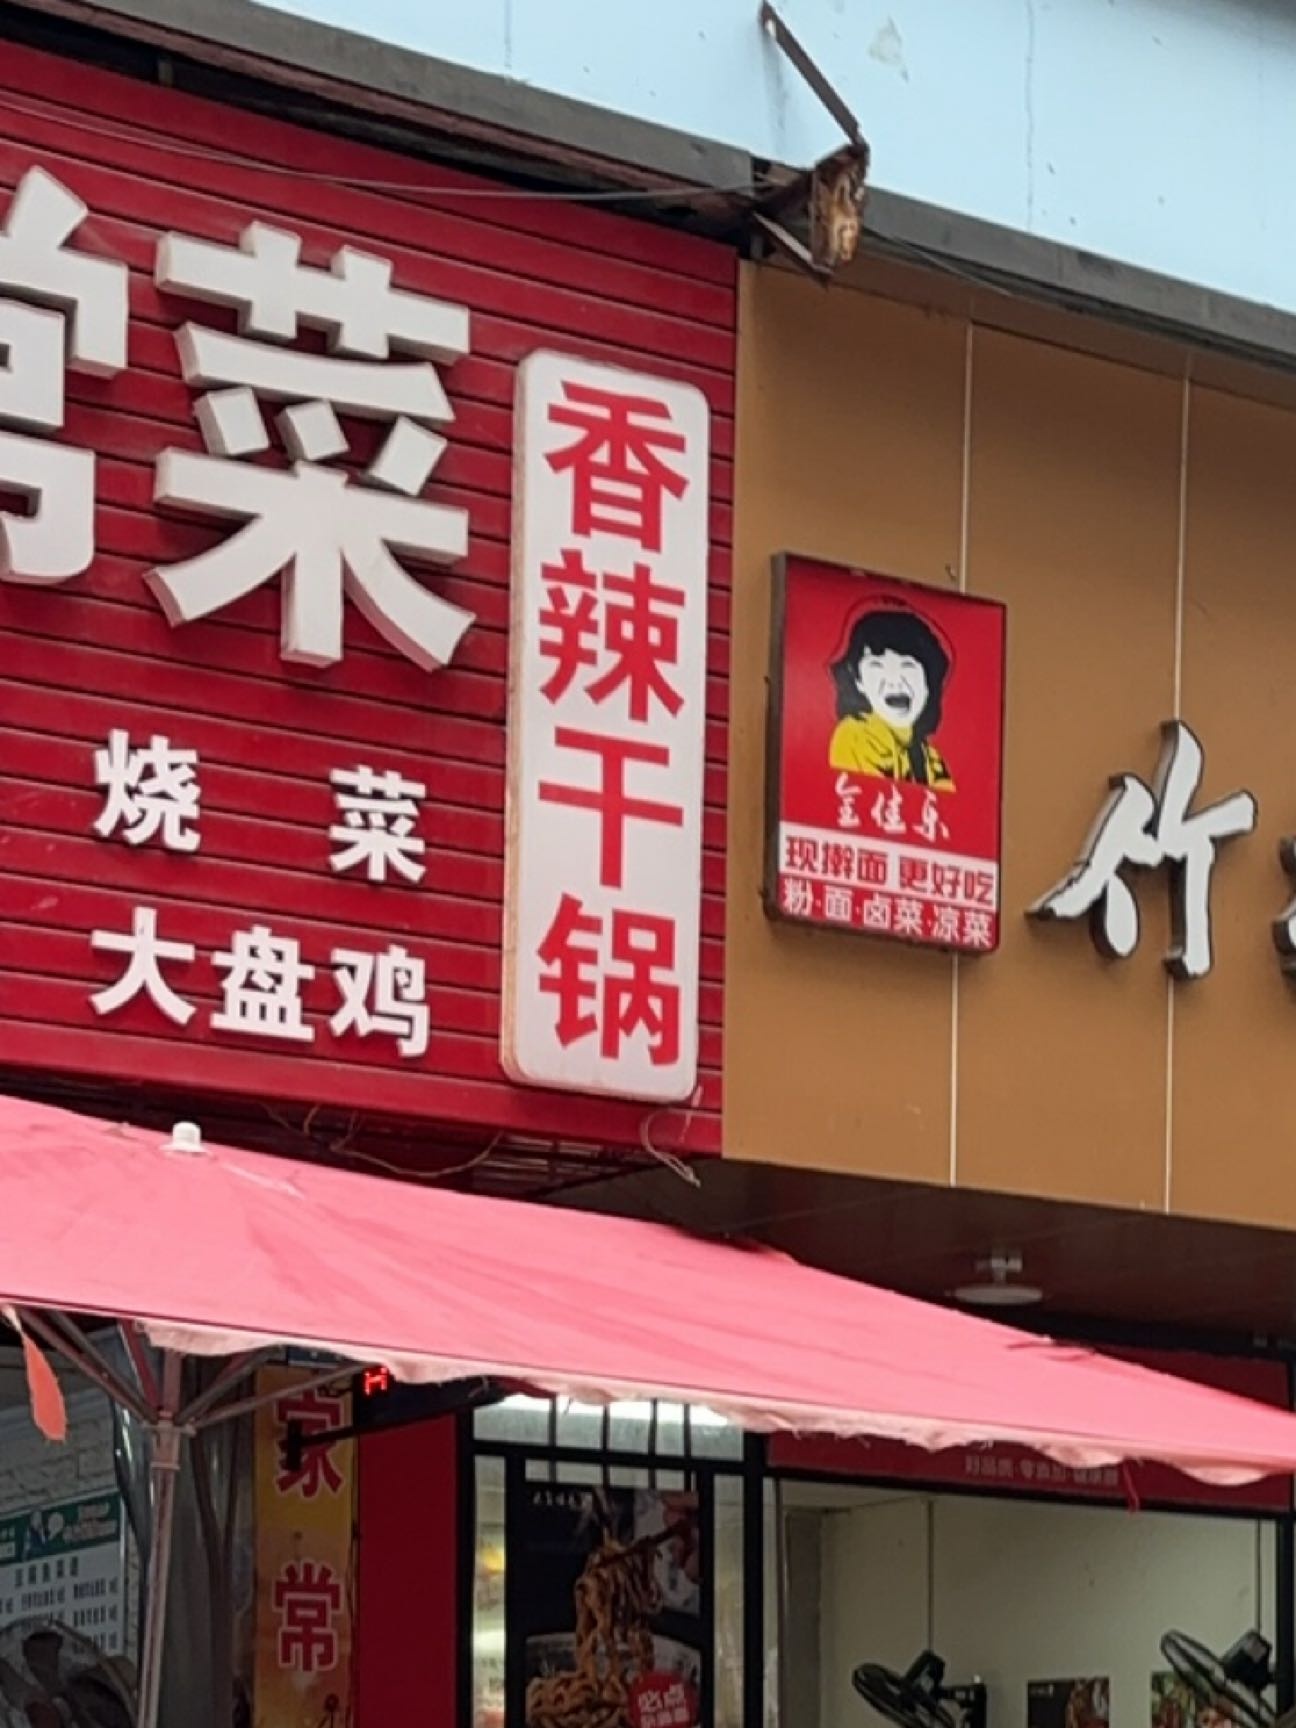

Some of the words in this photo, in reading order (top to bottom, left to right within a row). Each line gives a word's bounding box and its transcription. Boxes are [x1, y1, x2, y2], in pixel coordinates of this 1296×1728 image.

[538, 379, 690, 1068] 香辣干锅
[785, 834, 888, 886] 现擀面
[898, 854, 995, 907] 更好吃
[91, 907, 430, 1057] 大盘鸡
